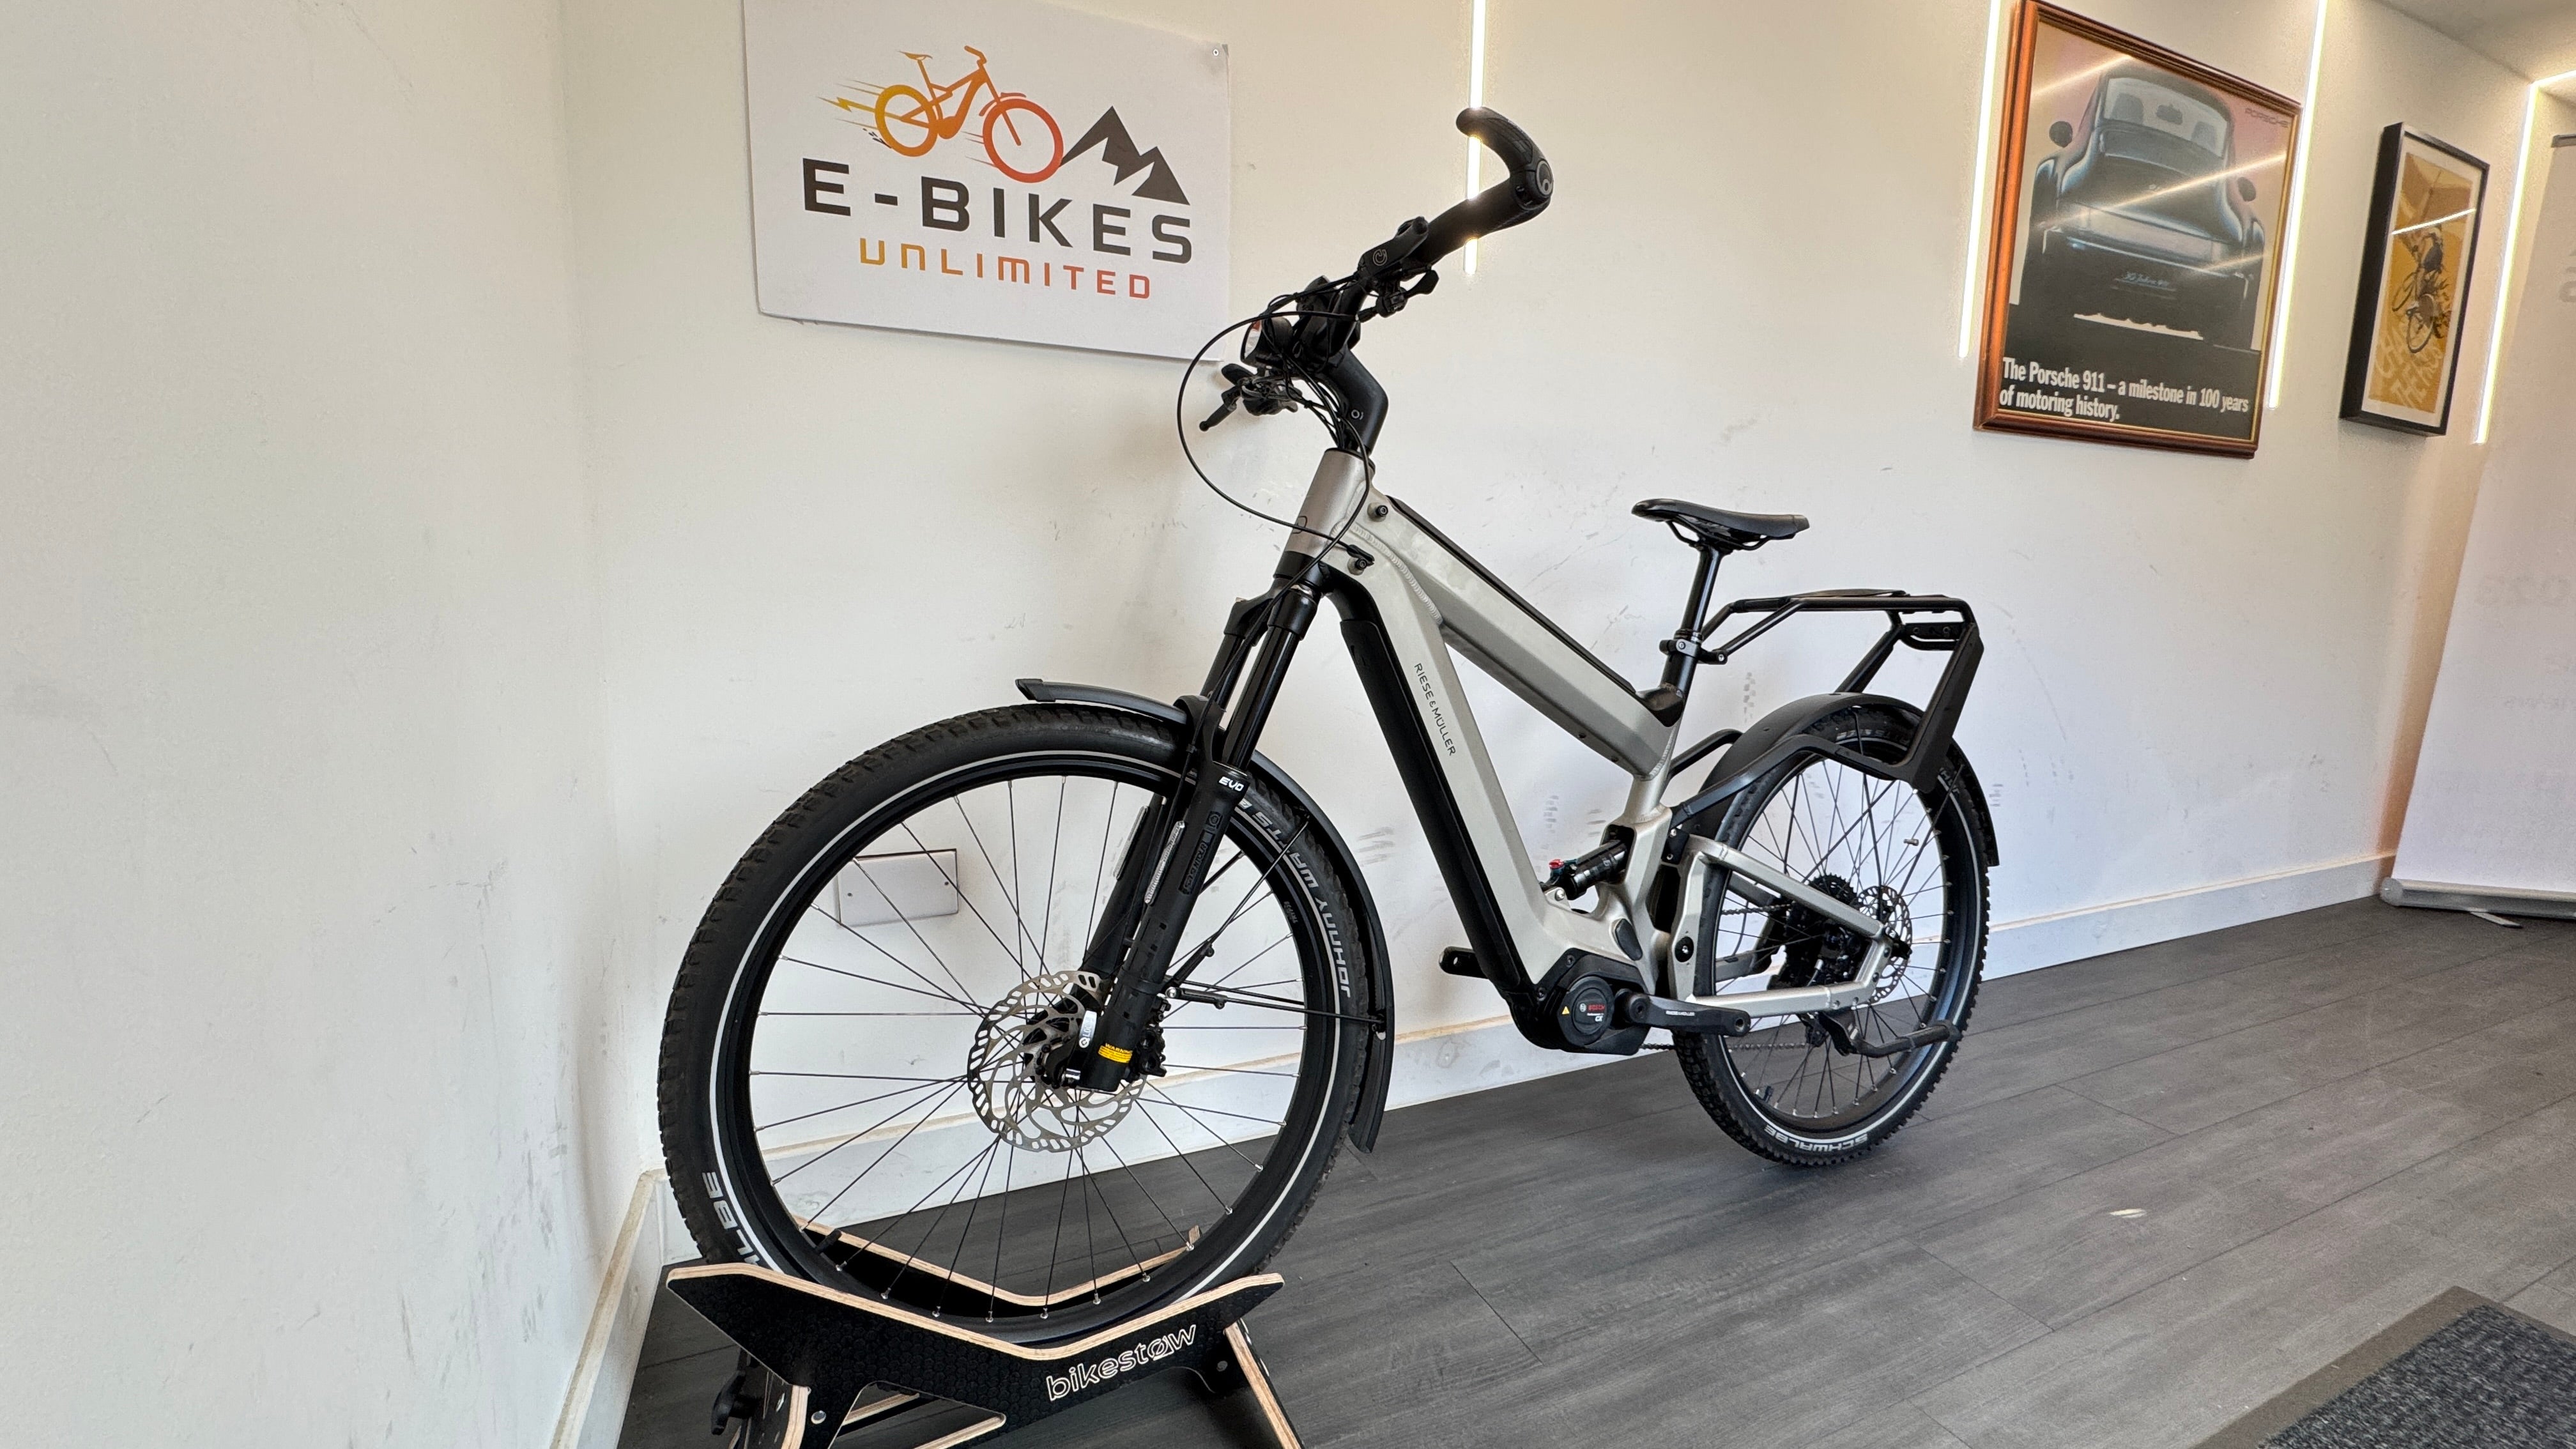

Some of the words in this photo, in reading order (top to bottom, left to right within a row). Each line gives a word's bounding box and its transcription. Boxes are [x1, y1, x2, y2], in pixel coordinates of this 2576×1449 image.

[802, 158, 1192, 264] E-BIKES
[859, 238, 1151, 299] UNLIMITED
[2000, 385, 2014, 406] of
[2016, 389, 2073, 417] motoring
[2076, 394, 2120, 422] history.
[2003, 357, 2027, 381] The
[2030, 361, 2079, 389] Porsche
[2083, 370, 2105, 393] 911
[2118, 381, 2126, 396] a
[2129, 379, 2184, 403] milestone
[2186, 385, 2196, 405] in
[2200, 388, 2220, 409] 100
[2221, 395, 2249, 413] years
[1414, 663, 1434, 700] RIESE
[1431, 707, 1456, 756] MÜLLER
[1218, 776, 1245, 792] EVO
[1315, 897, 1351, 998] JOHNNY
[1763, 1124, 1867, 1152] SCHWALBE
